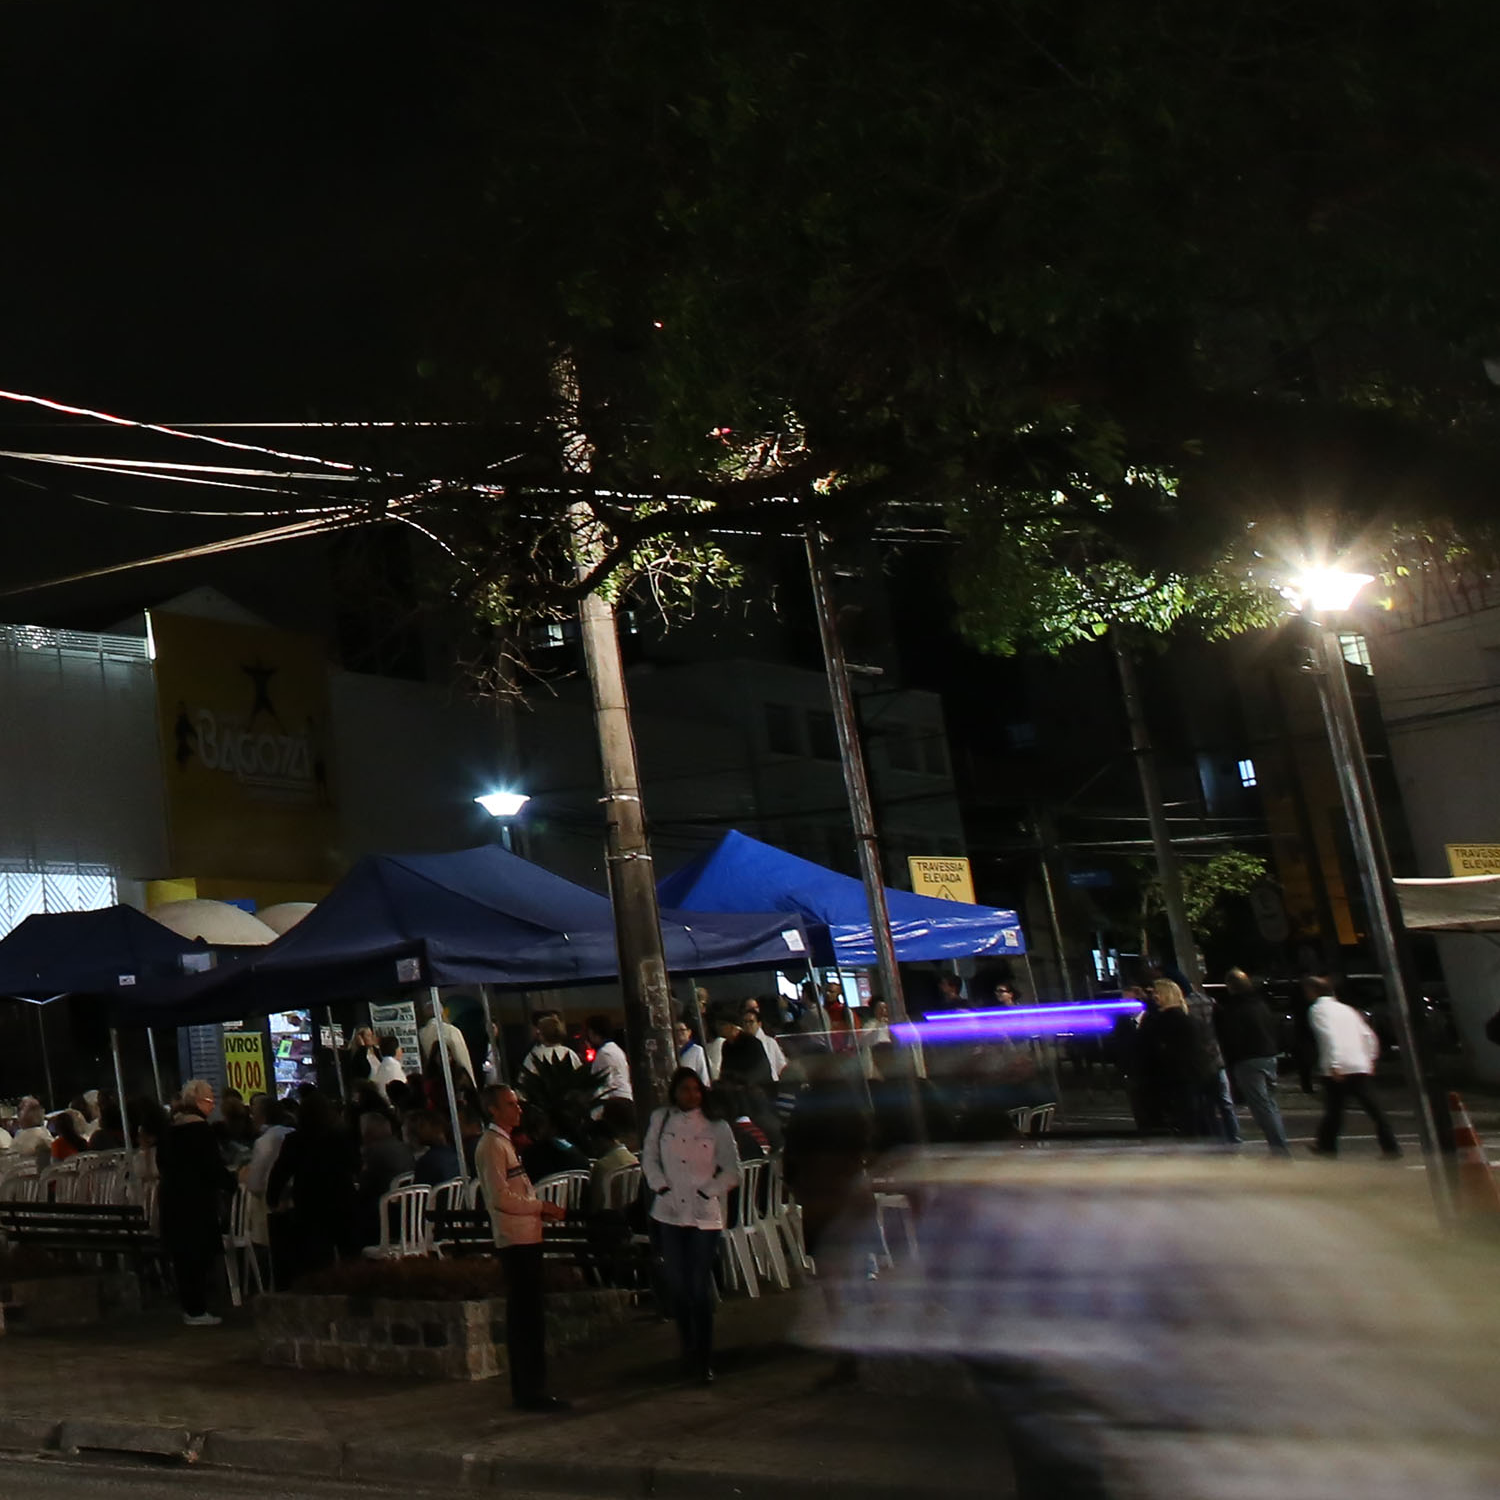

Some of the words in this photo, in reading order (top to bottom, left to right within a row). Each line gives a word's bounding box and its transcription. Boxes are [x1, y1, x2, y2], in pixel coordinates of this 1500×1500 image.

[1454, 849, 1500, 858] TRAVESS
[916, 861, 964, 872] TRAVESSIA
[1462, 859, 1500, 869] ELEVAD
[923, 872, 961, 883] ELEVADA
[225, 1036, 259, 1053] IVROS
[227, 1060, 261, 1094] 10,00
